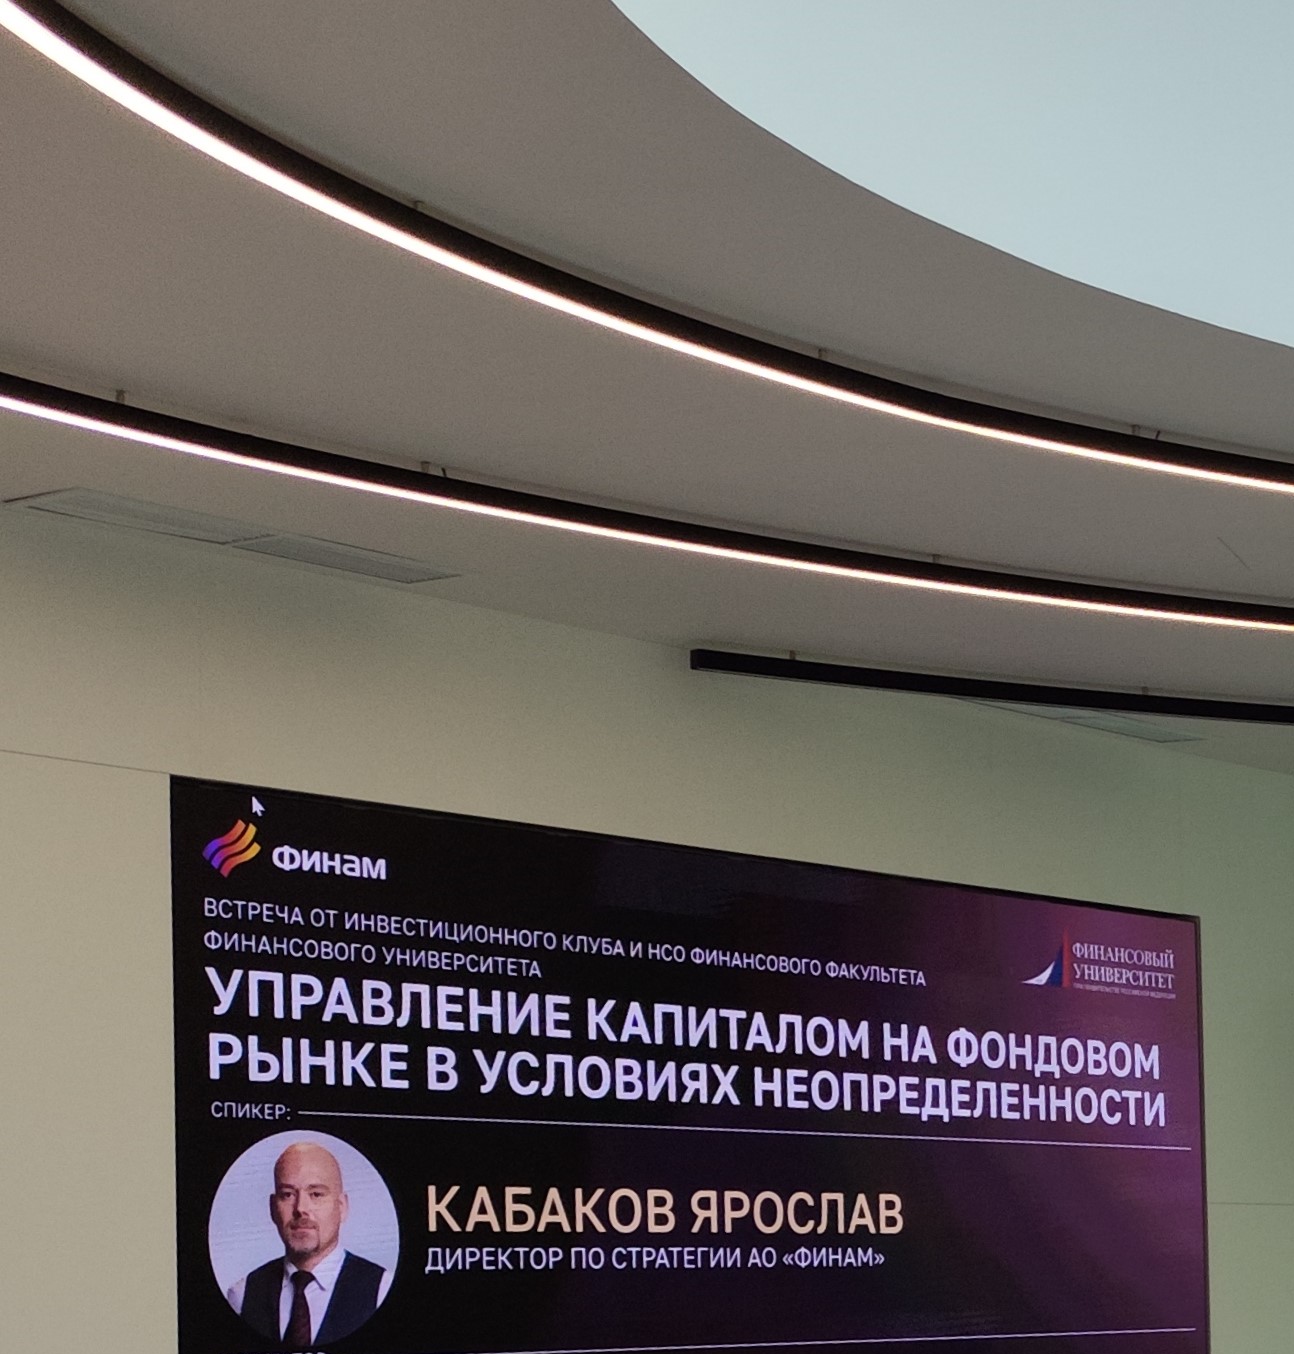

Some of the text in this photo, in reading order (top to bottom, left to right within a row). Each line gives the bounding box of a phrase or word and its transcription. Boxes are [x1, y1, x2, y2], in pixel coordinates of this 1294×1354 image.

[203, 929, 542, 978] ФИНАНСОВОГО УНИВЕРСИТЕТА
[204, 897, 927, 987] ВСТРЕЧА ОТ ИНВЕСТИЦИОННОГО КЛУБА И НСО ФИНАНСОВОГО ФАКУЛЬТЕТА
[1072, 943, 1175, 969] ФИНАНСОВЫЙ
[1073, 963, 1175, 989] УНИВЕРСИТЕТ
[204, 966, 1160, 1080] УПРАВЛЕНИЕ КАПИТАЛОМ НА ФОНДОВОМ
[208, 1032, 1166, 1127] РЫНКЕ В УСЛОВИЯХ НЕОПРЕДЕЛЕННОСТИ
[210, 1101, 291, 1121] СПИКЕР:
[427, 1184, 904, 1235] КАБАКОВ ЯРОСЛАВ
[424, 1246, 885, 1274] ДИРЕКТОР ПО СТРАТЕГИИ АО «ФИНАМ»
